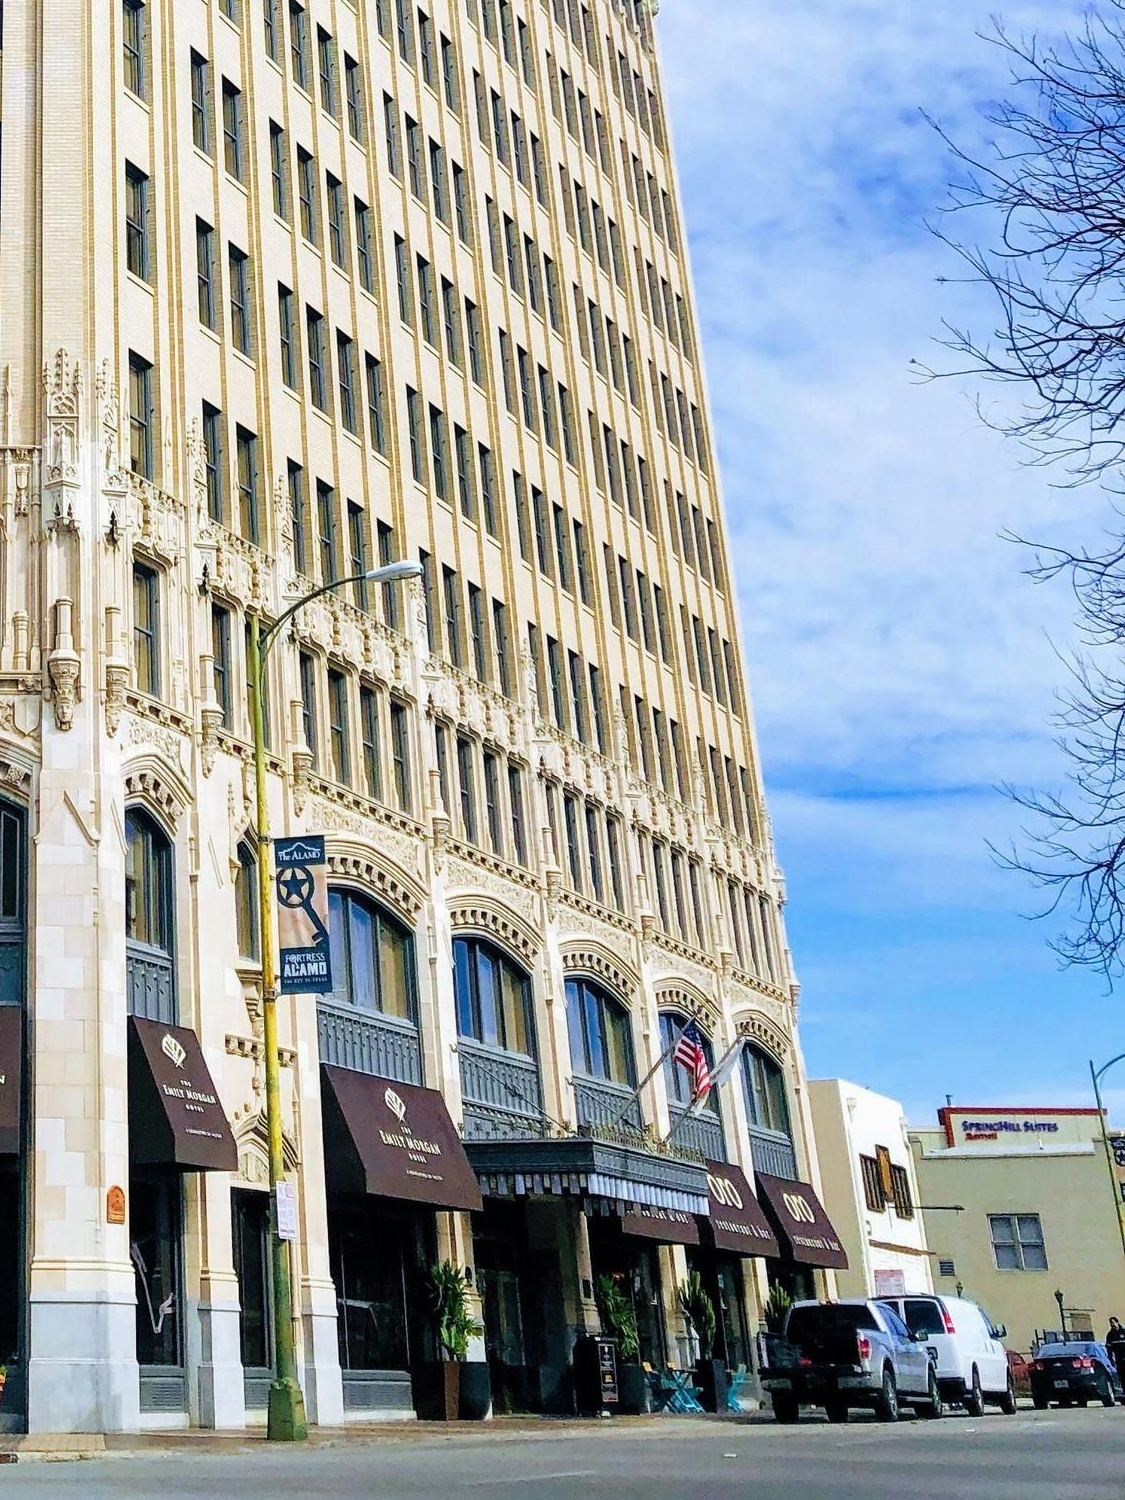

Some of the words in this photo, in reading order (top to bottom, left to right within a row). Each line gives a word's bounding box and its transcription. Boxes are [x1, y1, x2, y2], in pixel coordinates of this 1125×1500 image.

[291, 850, 321, 861] ALAMO
[285, 953, 325, 963] FORTRESS
[284, 962, 327, 977] ALAMO
[162, 1084, 185, 1098] EMILY
[186, 1090, 216, 1104] MORGAN
[379, 1129, 407, 1148] EMILY
[406, 1135, 442, 1155] MORGAN
[707, 1173, 743, 1209] oro
[783, 1193, 815, 1223] oro
[715, 1219, 753, 1236] restaurant
